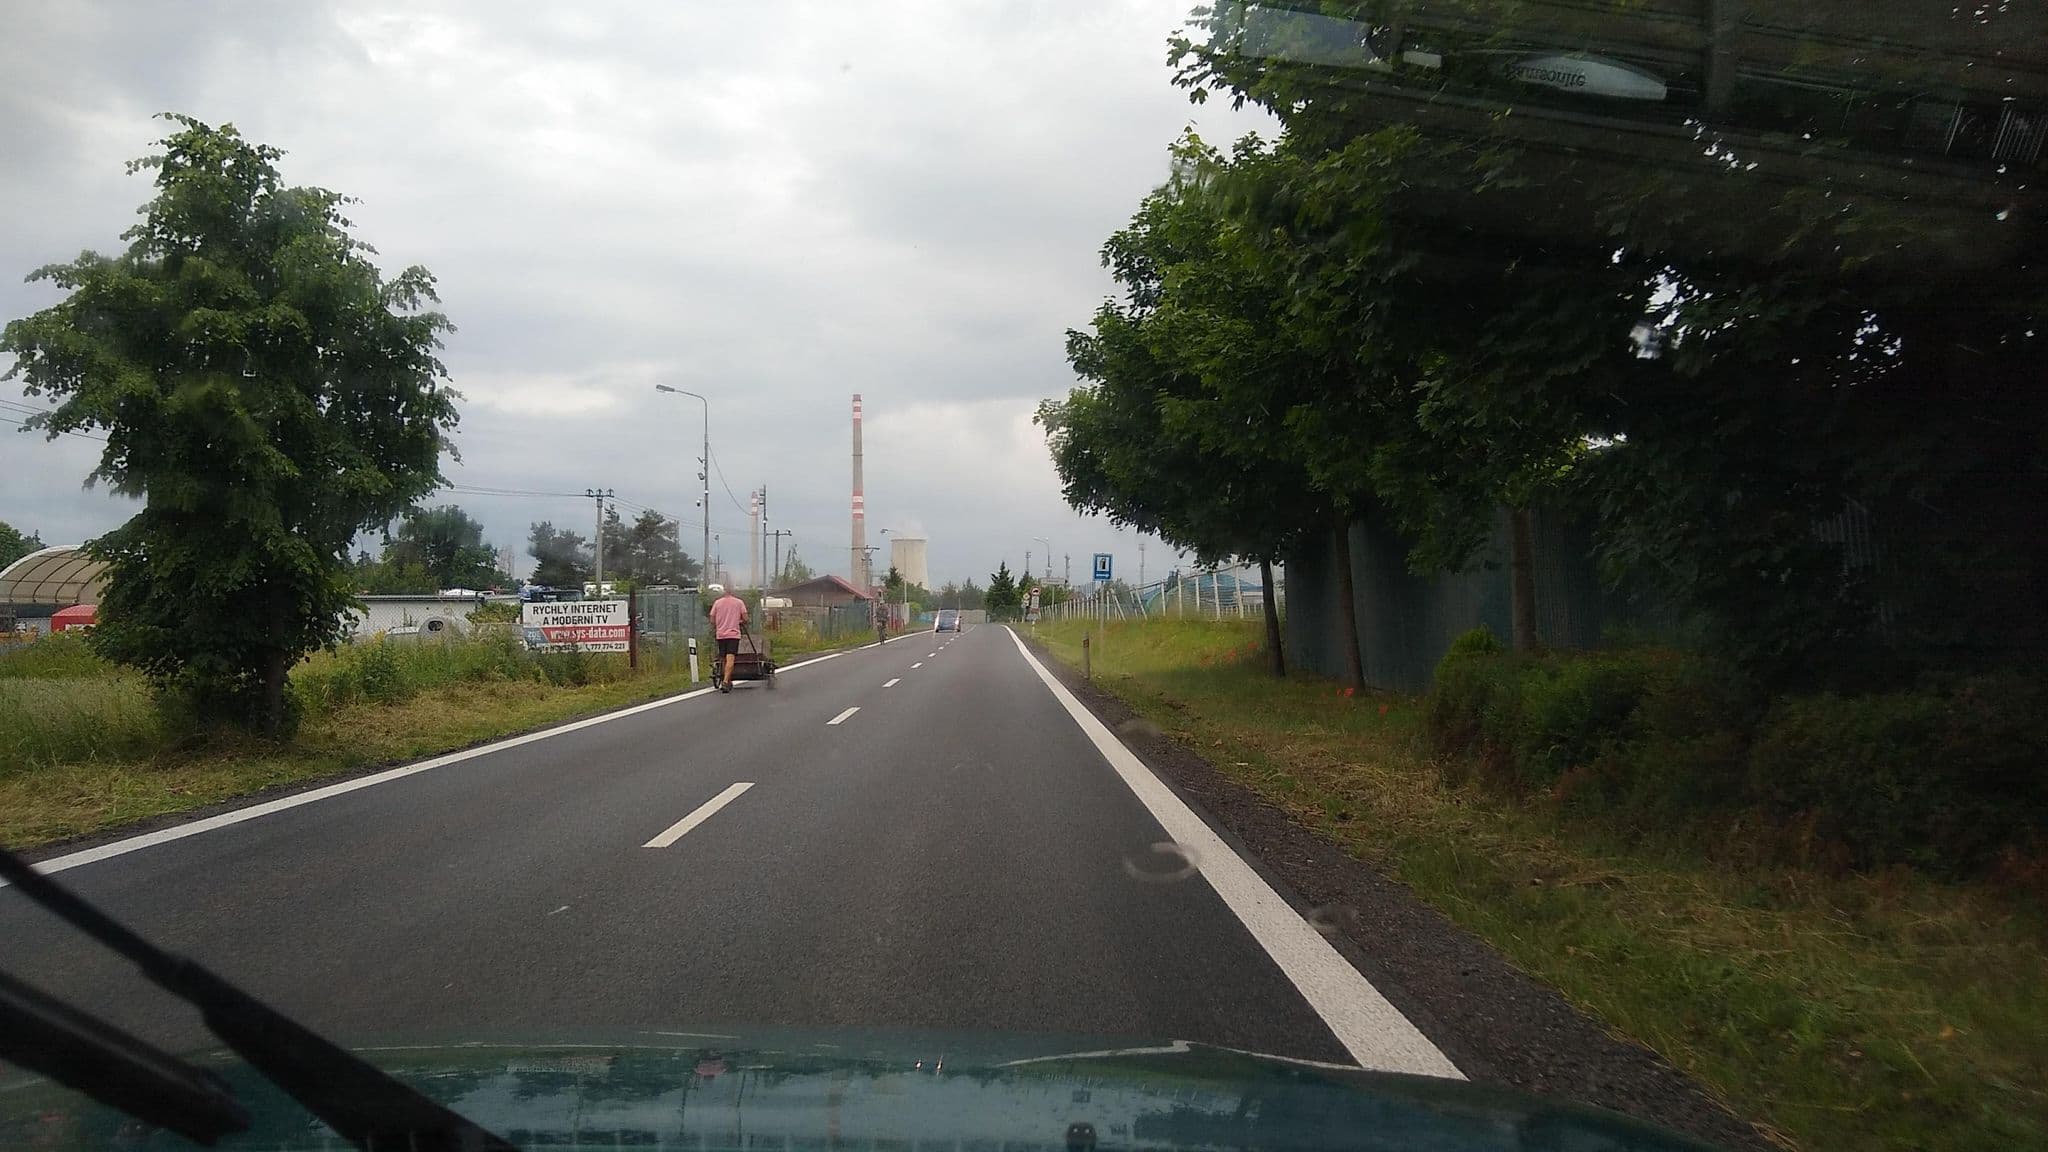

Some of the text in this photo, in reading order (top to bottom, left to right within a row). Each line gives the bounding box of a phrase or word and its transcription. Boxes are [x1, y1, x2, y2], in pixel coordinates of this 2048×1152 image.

[533, 603, 618, 615] RYCHLÝ INTERNET
[542, 614, 608, 626] A MODERNÍ TV
